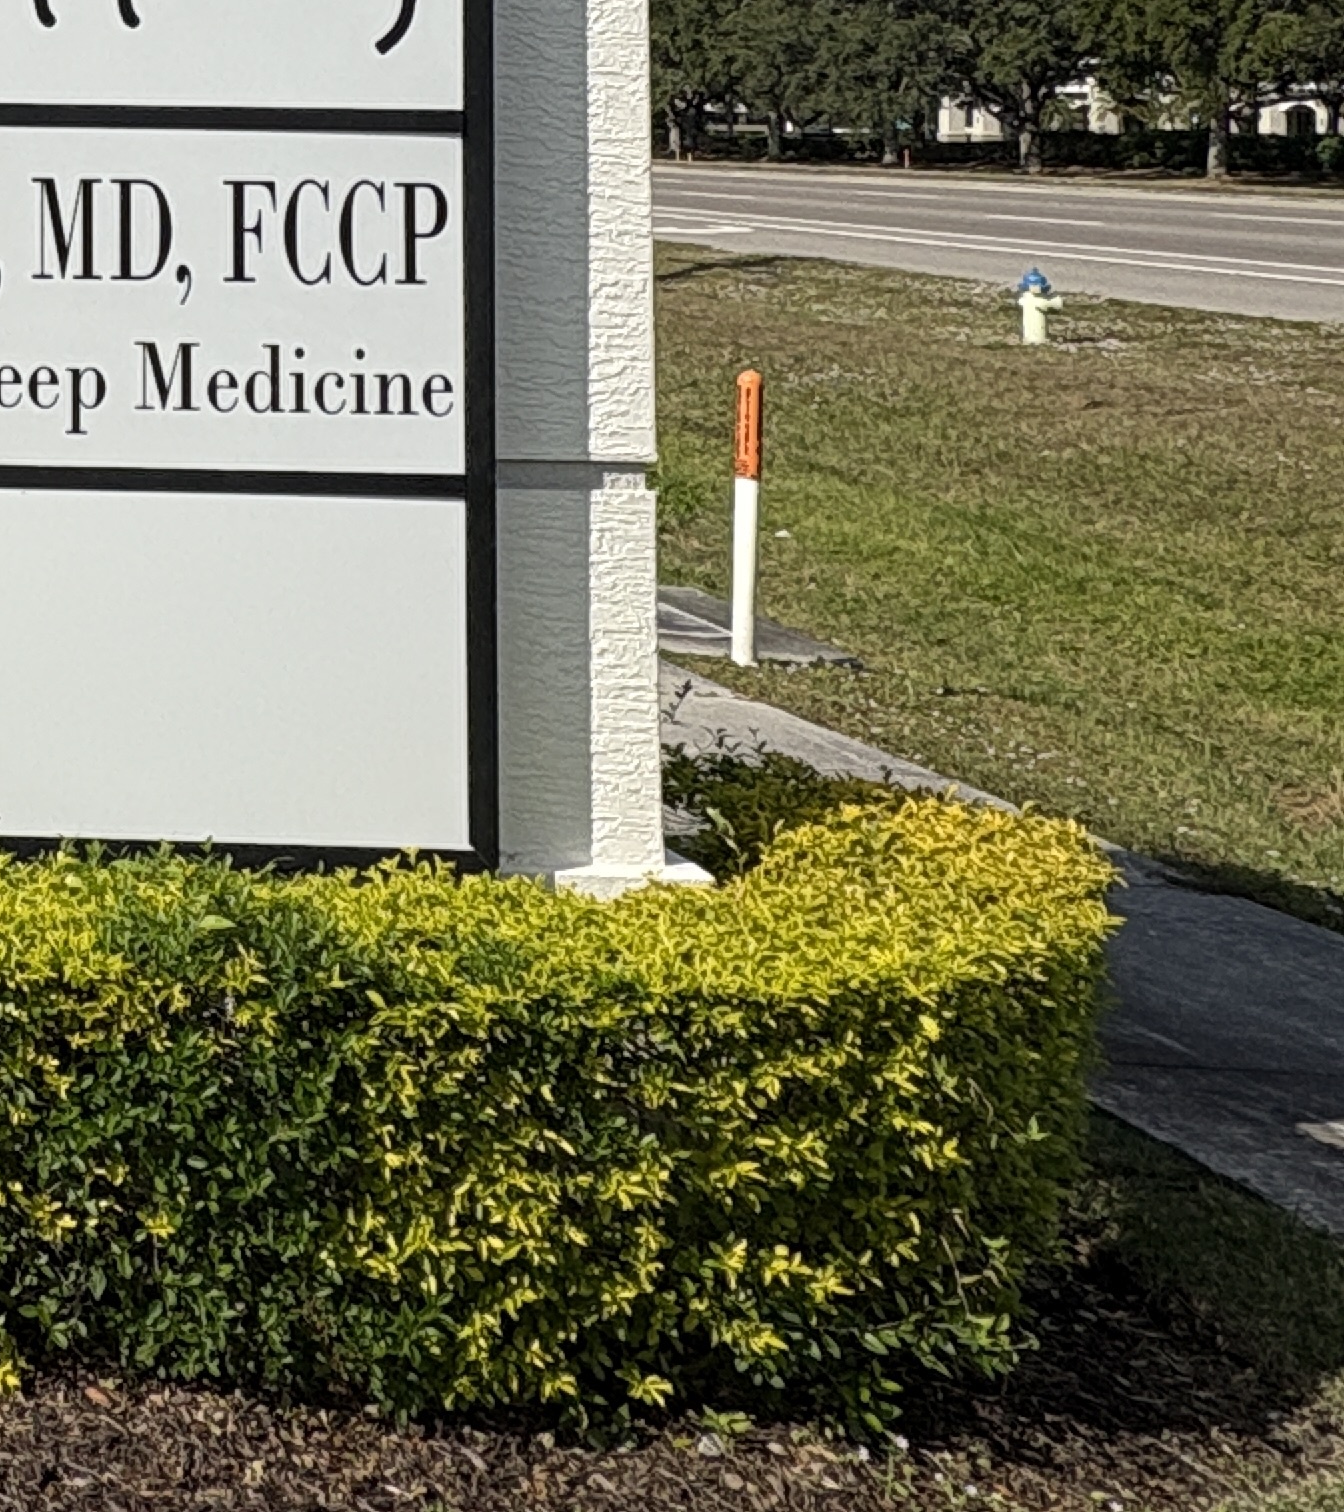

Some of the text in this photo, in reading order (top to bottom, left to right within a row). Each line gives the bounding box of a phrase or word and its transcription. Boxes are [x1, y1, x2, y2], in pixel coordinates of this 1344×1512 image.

[31, 176, 193, 305] MD,
[221, 179, 450, 287] FCCP
[134, 341, 455, 419] Medicine
